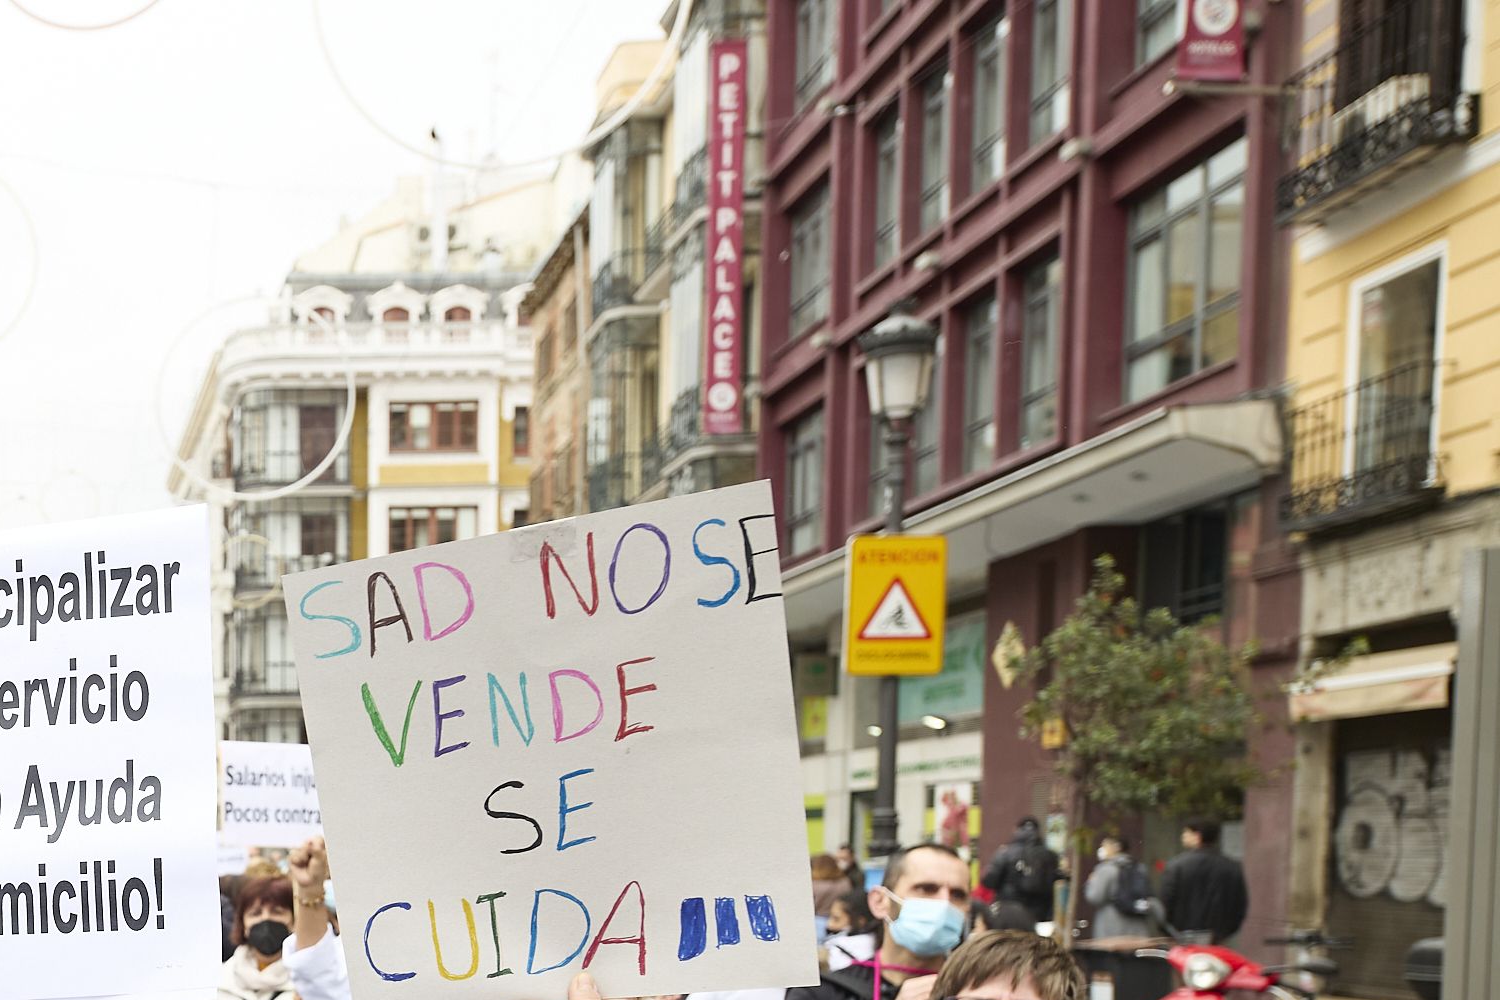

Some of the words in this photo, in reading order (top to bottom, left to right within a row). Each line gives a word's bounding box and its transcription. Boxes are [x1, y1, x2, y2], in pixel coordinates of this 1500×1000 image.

[717, 52, 741, 199] PETIT
[712, 206, 740, 379] PALACE
[300, 561, 475, 658] SAD
[361, 656, 657, 767] VENDE
[13, 759, 162, 844] Ayuda
[225, 765, 286, 787] Salarios
[225, 801, 269, 823] Pocos
[484, 768, 596, 854] SE
[363, 880, 646, 982] CUIDA
